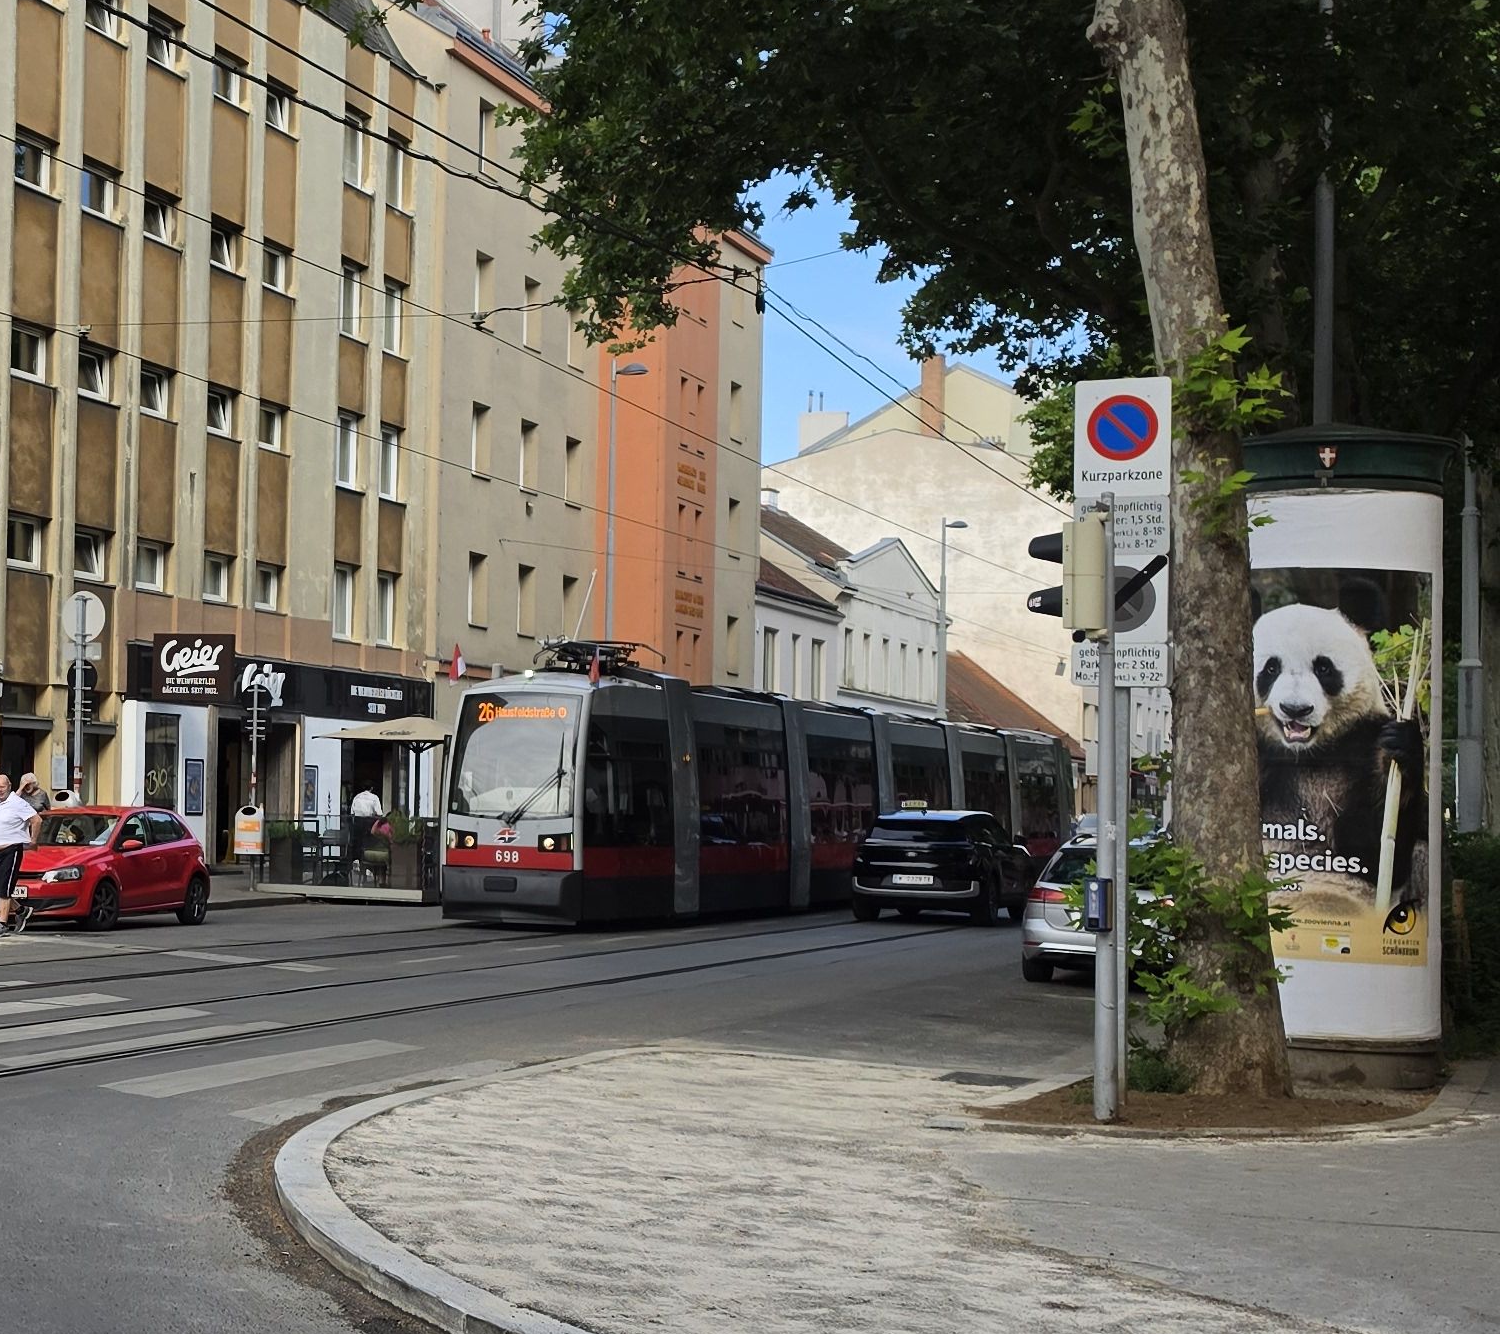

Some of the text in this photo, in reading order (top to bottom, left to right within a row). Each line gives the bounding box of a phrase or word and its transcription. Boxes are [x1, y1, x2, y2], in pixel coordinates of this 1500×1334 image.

[1081, 469, 1163, 483] Kurzparkzone
[1146, 515, 1164, 524] Std.
[160, 638, 224, 674] Geier
[1131, 660, 1138, 670] 2
[1140, 660, 1158, 670] Std.
[478, 702, 494, 722] 26
[495, 706, 556, 719] Hausfeldstraße
[1262, 818, 1326, 843] mals.
[495, 849, 519, 863] 698
[1268, 849, 1369, 875] species.
